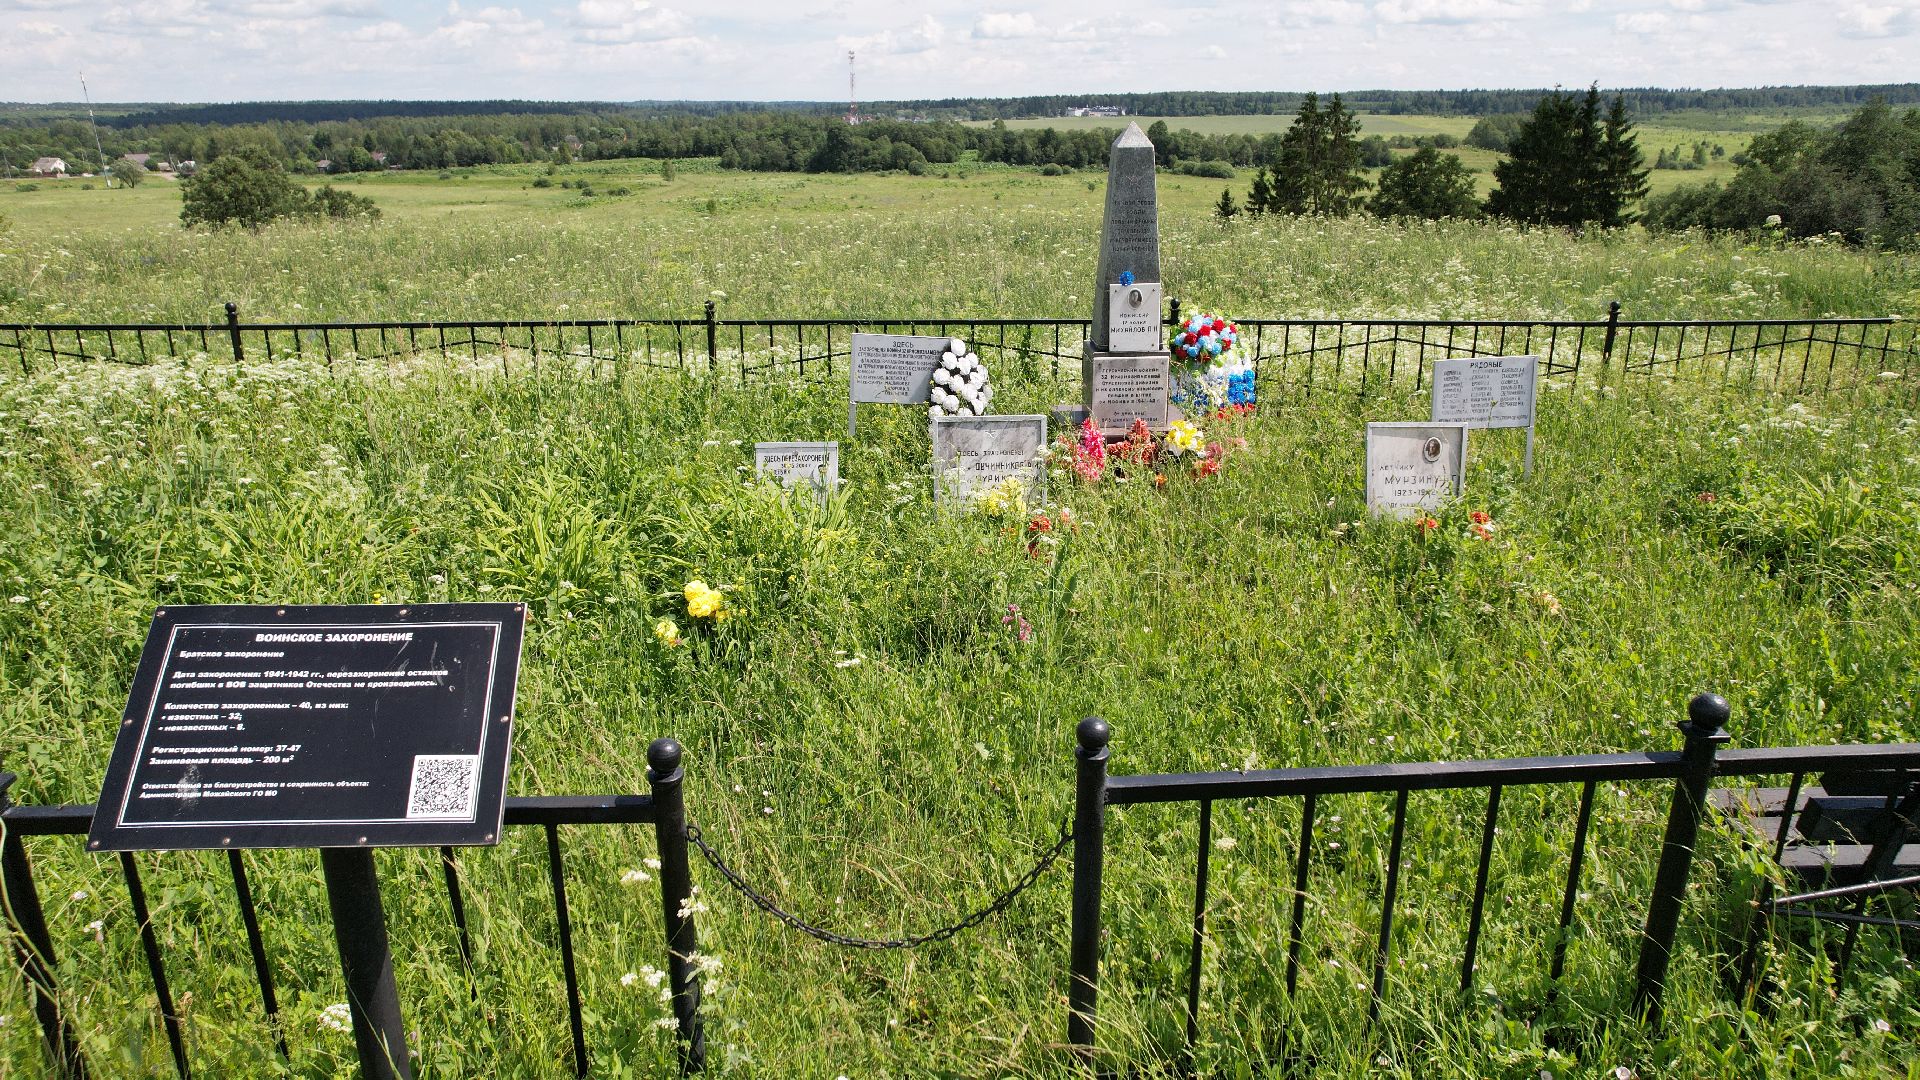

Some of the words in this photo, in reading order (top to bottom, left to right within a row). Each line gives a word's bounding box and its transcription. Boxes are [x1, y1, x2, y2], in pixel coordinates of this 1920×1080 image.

[1470, 360, 1503, 369] РЯДОВЫЕ
[763, 455, 781, 463] ЗДЕСЬ
[1384, 475, 1439, 486] МУРЗИНУ
[255, 633, 323, 643] ВОИНСКОЕ
[325, 632, 414, 642] ЗАХОРОНЕНИЕ
[179, 650, 223, 659] Братское
[224, 650, 285, 659] захоронение
[172, 671, 196, 679] Дата
[197, 671, 262, 680] захоронения:
[263, 670, 309, 678] 1941-1942
[326, 670, 406, 680] перезахоронение
[407, 669, 449, 677] останков
[169, 681, 217, 690] погибших
[225, 680, 246, 688] ВОВ
[248, 681, 304, 689] защитников
[305, 680, 352, 688] Отечества
[367, 680, 438, 689] производилось.
[164, 702, 219, 710] Количество
[220, 701, 290, 710] захороненных
[298, 701, 312, 710] 40,
[167, 713, 219, 721] известных
[227, 712, 242, 722] 32;
[164, 724, 228, 732] неизвестных
[151, 745, 239, 754] Регистрационный
[240, 745, 273, 754] номер:
[275, 744, 302, 752] 37-47
[149, 757, 210, 765] Занимаемая
[211, 757, 254, 765] площадь
[262, 756, 281, 764] 200
[142, 782, 202, 790] Ответственный
[213, 781, 278, 790] благоустройство
[286, 781, 335, 789] сохранность
[139, 790, 202, 799] Администрация
[202, 790, 252, 798] Можайского
